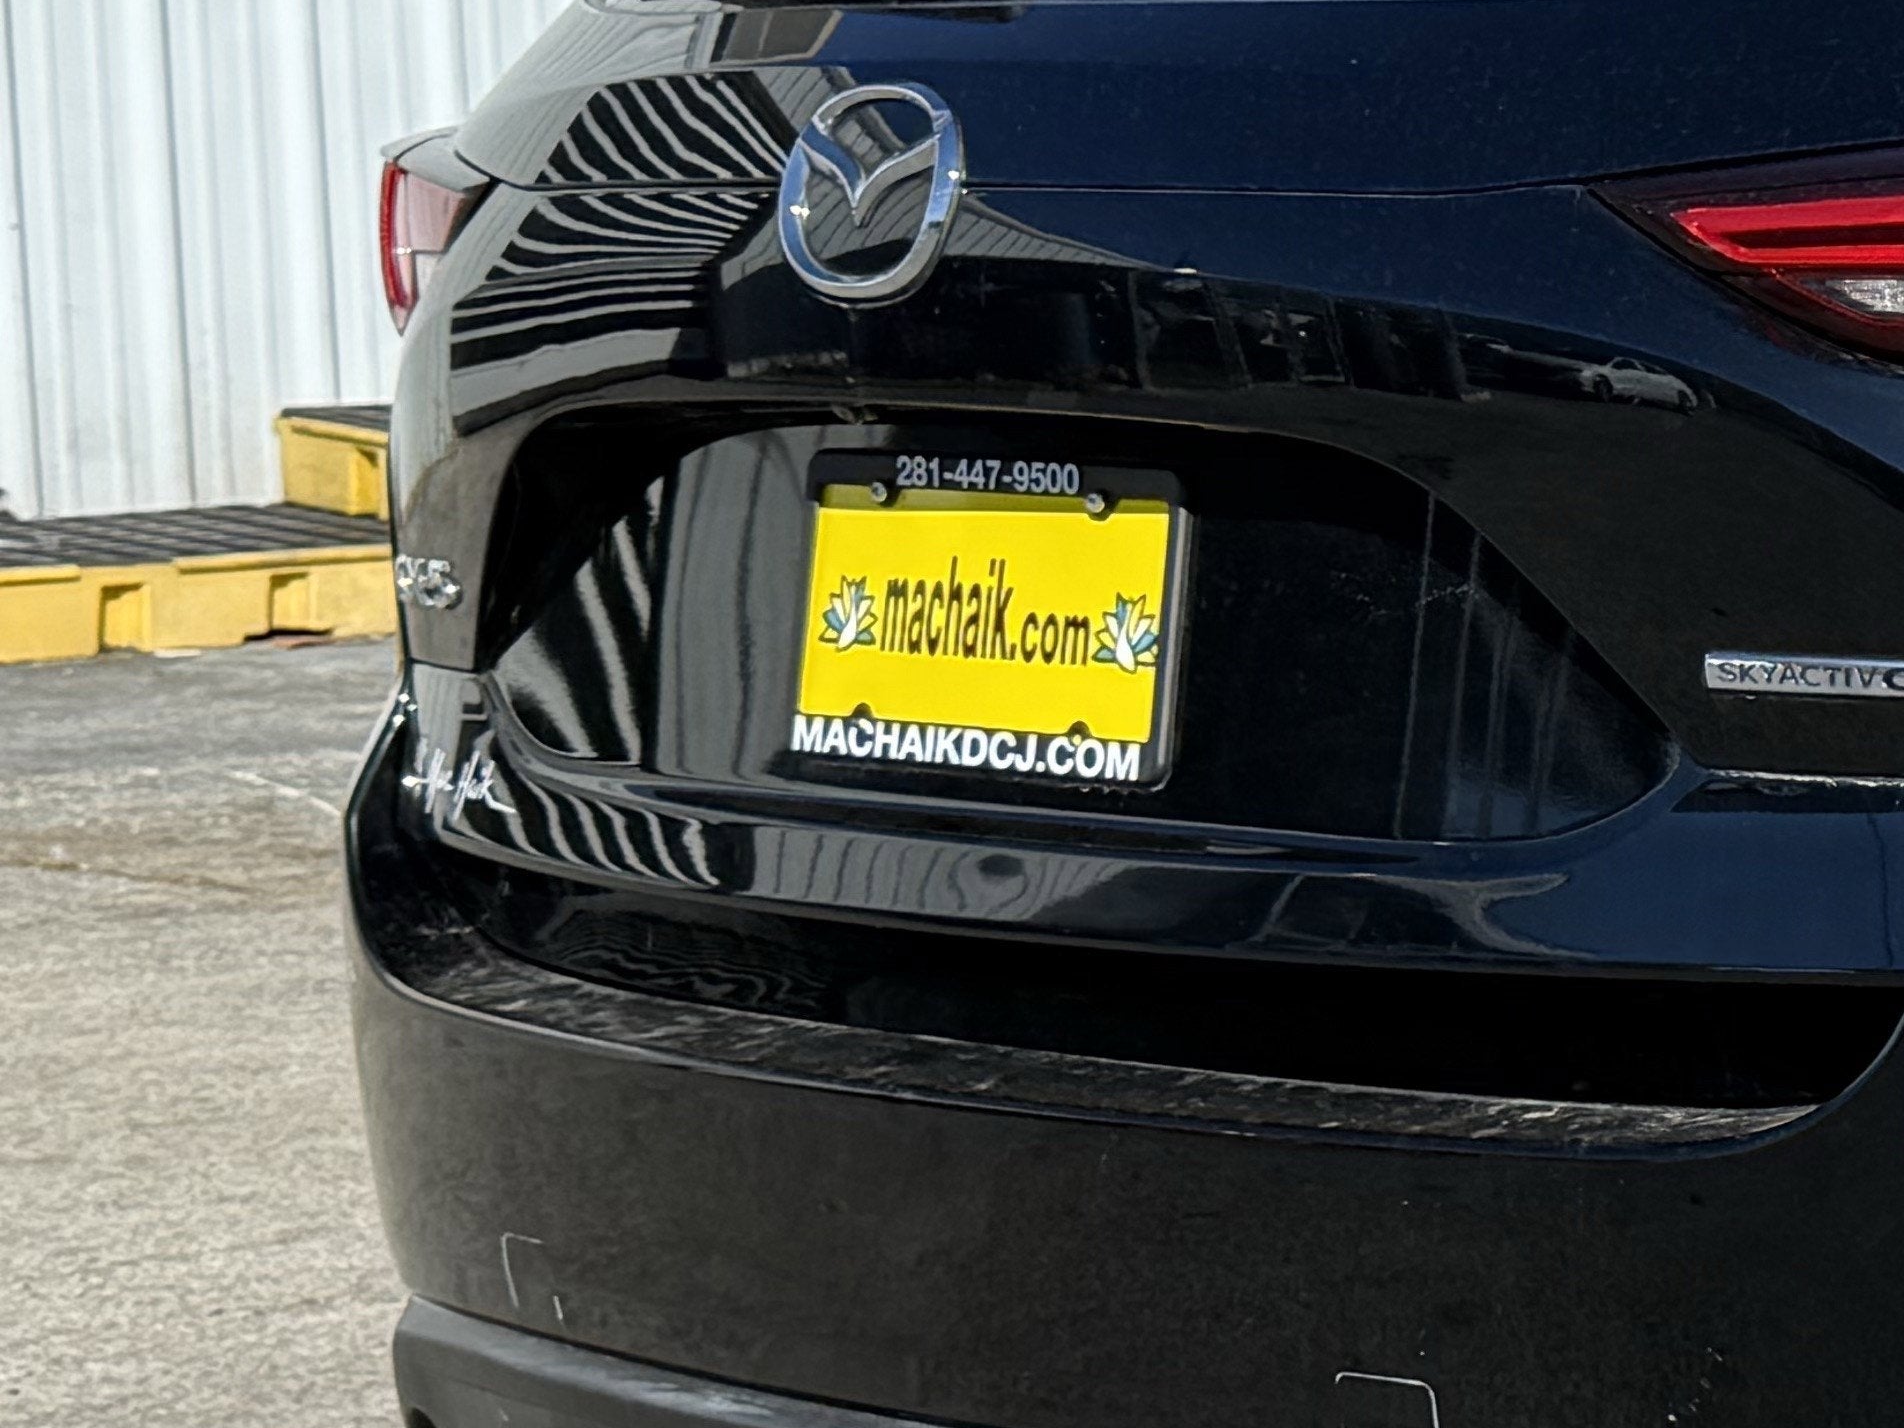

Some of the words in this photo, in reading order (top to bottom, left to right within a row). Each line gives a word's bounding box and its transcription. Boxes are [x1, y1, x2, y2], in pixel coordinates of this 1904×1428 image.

[896, 454, 1080, 495] 281-447-9500
[879, 555, 1091, 666] machaik.com
[790, 714, 1142, 782] MACHAIKDCJ.COM
